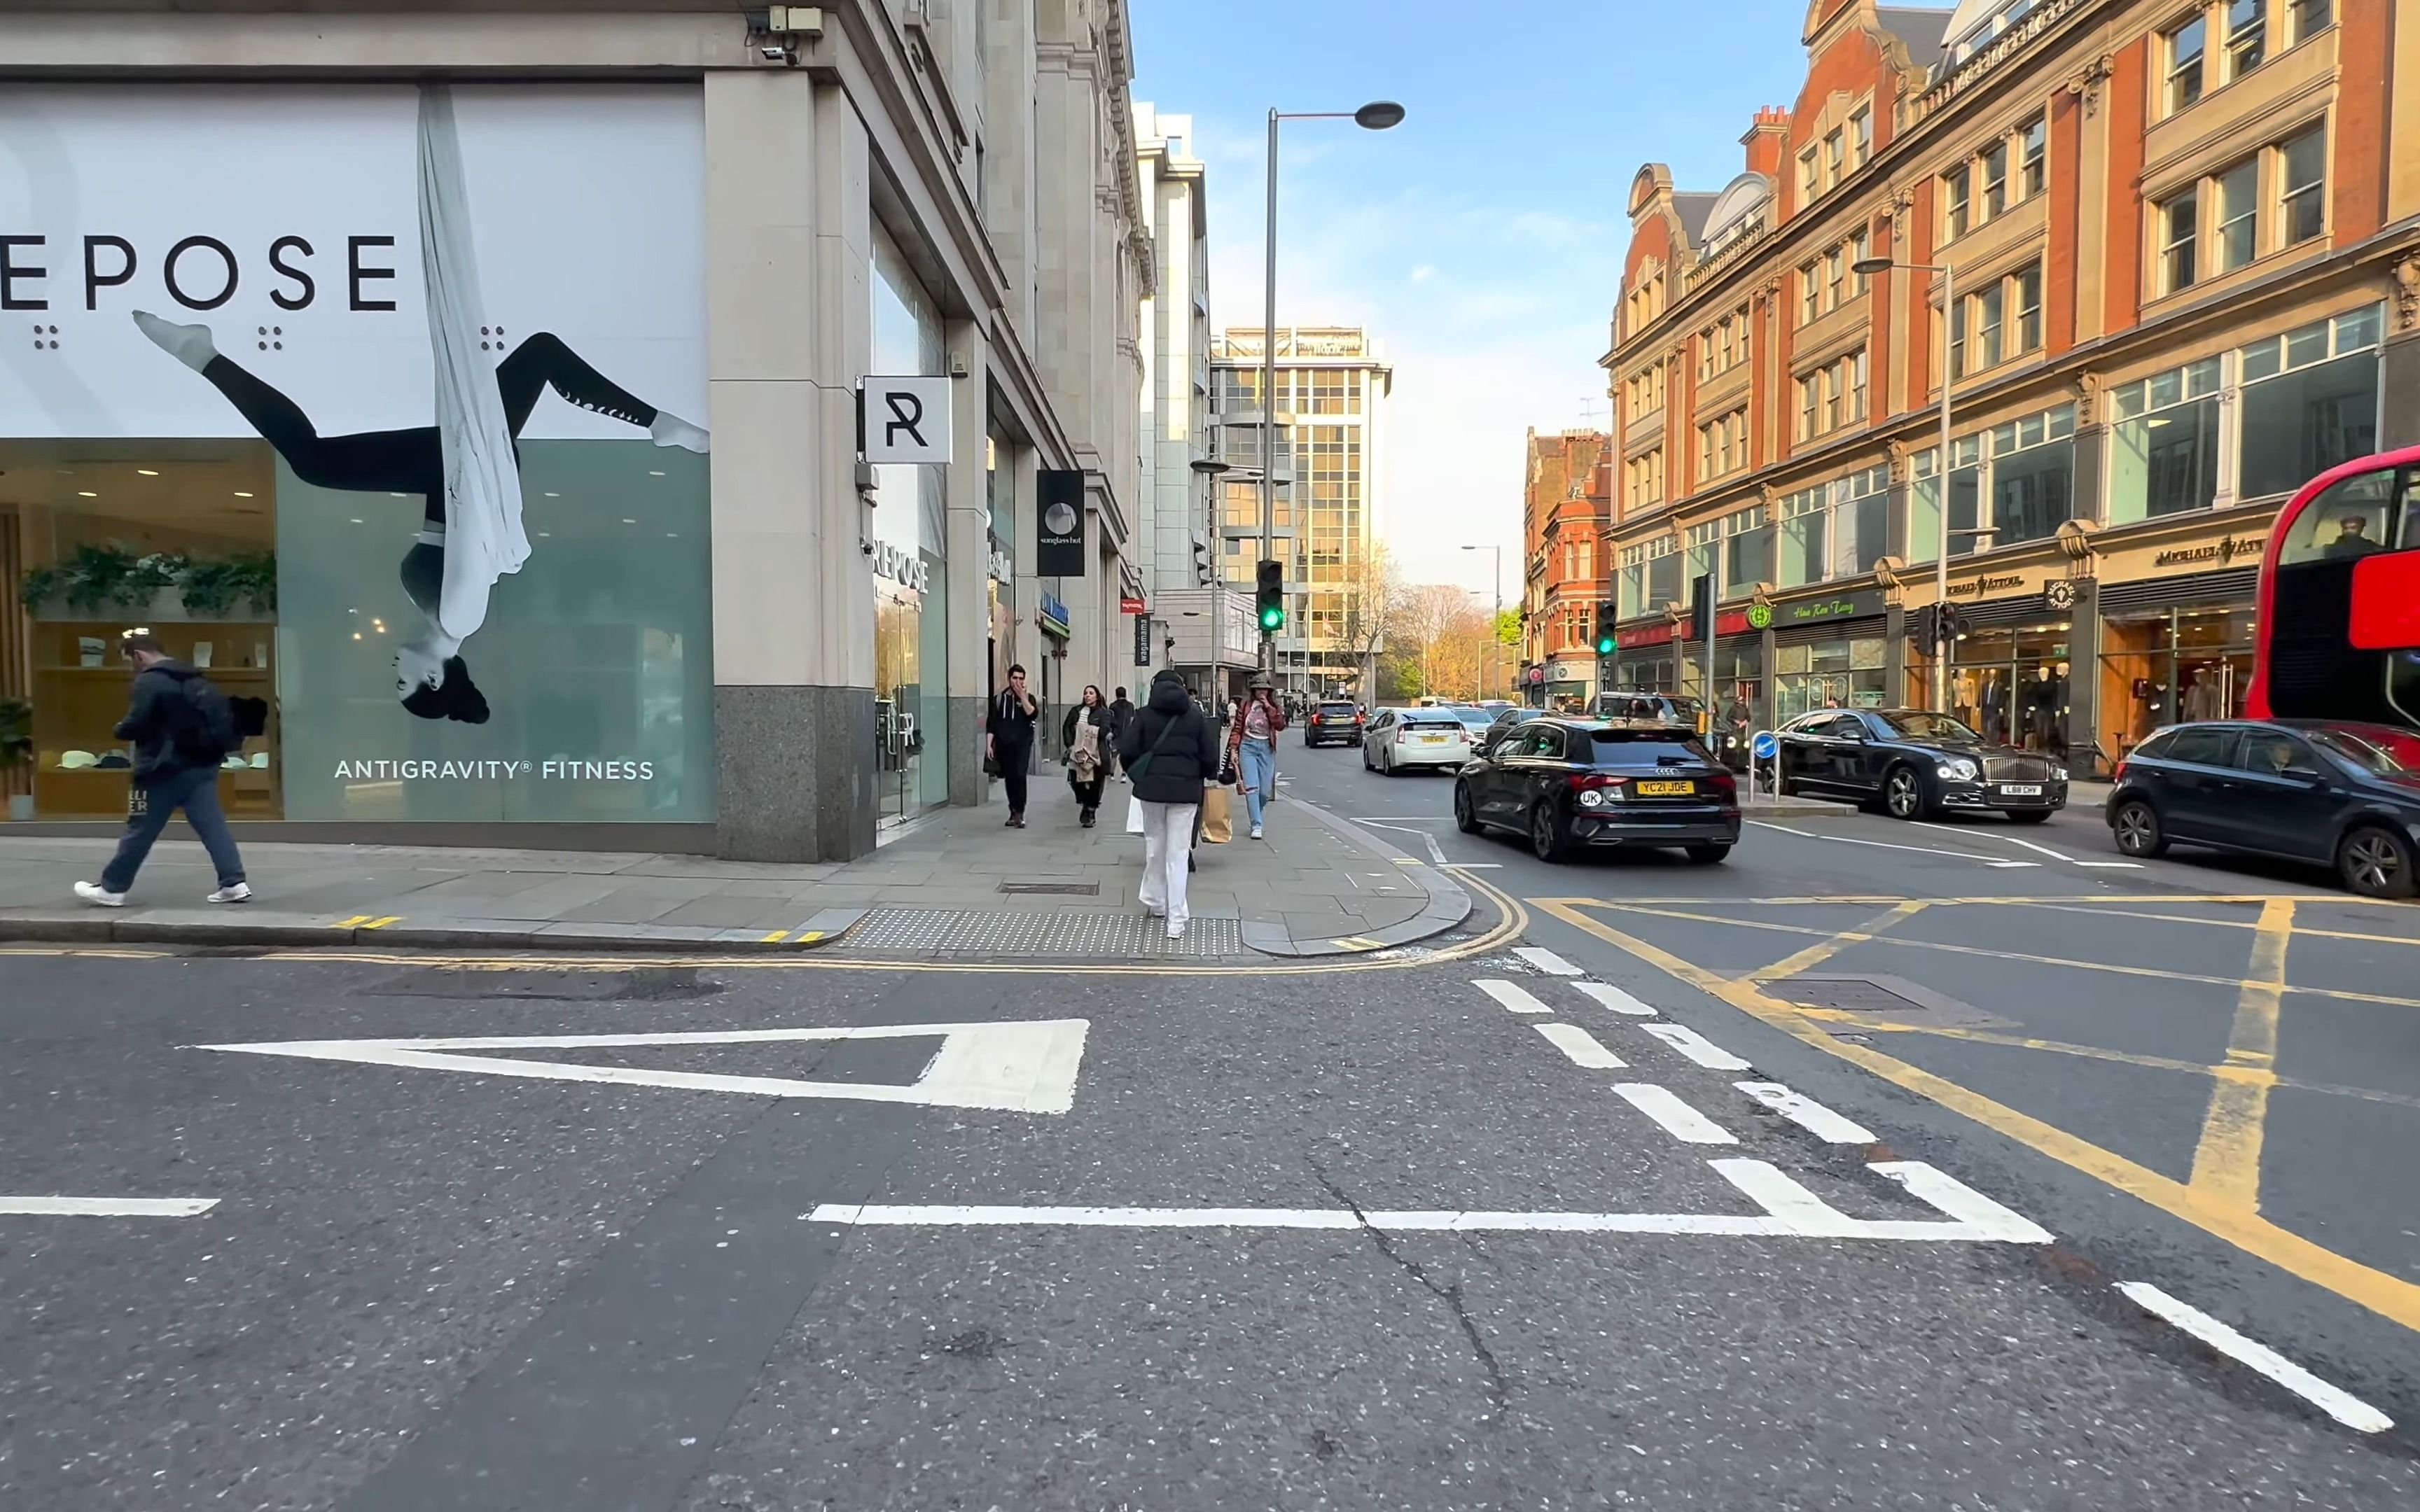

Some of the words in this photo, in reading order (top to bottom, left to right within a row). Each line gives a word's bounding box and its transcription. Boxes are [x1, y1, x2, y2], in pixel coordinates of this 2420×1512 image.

[1040, 536, 1069, 546] sunglass
[2155, 546, 2220, 566] MICHAEL
[2235, 538, 2267, 554] ATT
[1141, 619, 1149, 662] wagamama
[542, 760, 654, 780] FITNESS
[1643, 783, 1667, 792] YC21
[1669, 782, 1688, 792] JDE
[1583, 793, 1598, 804] UK
